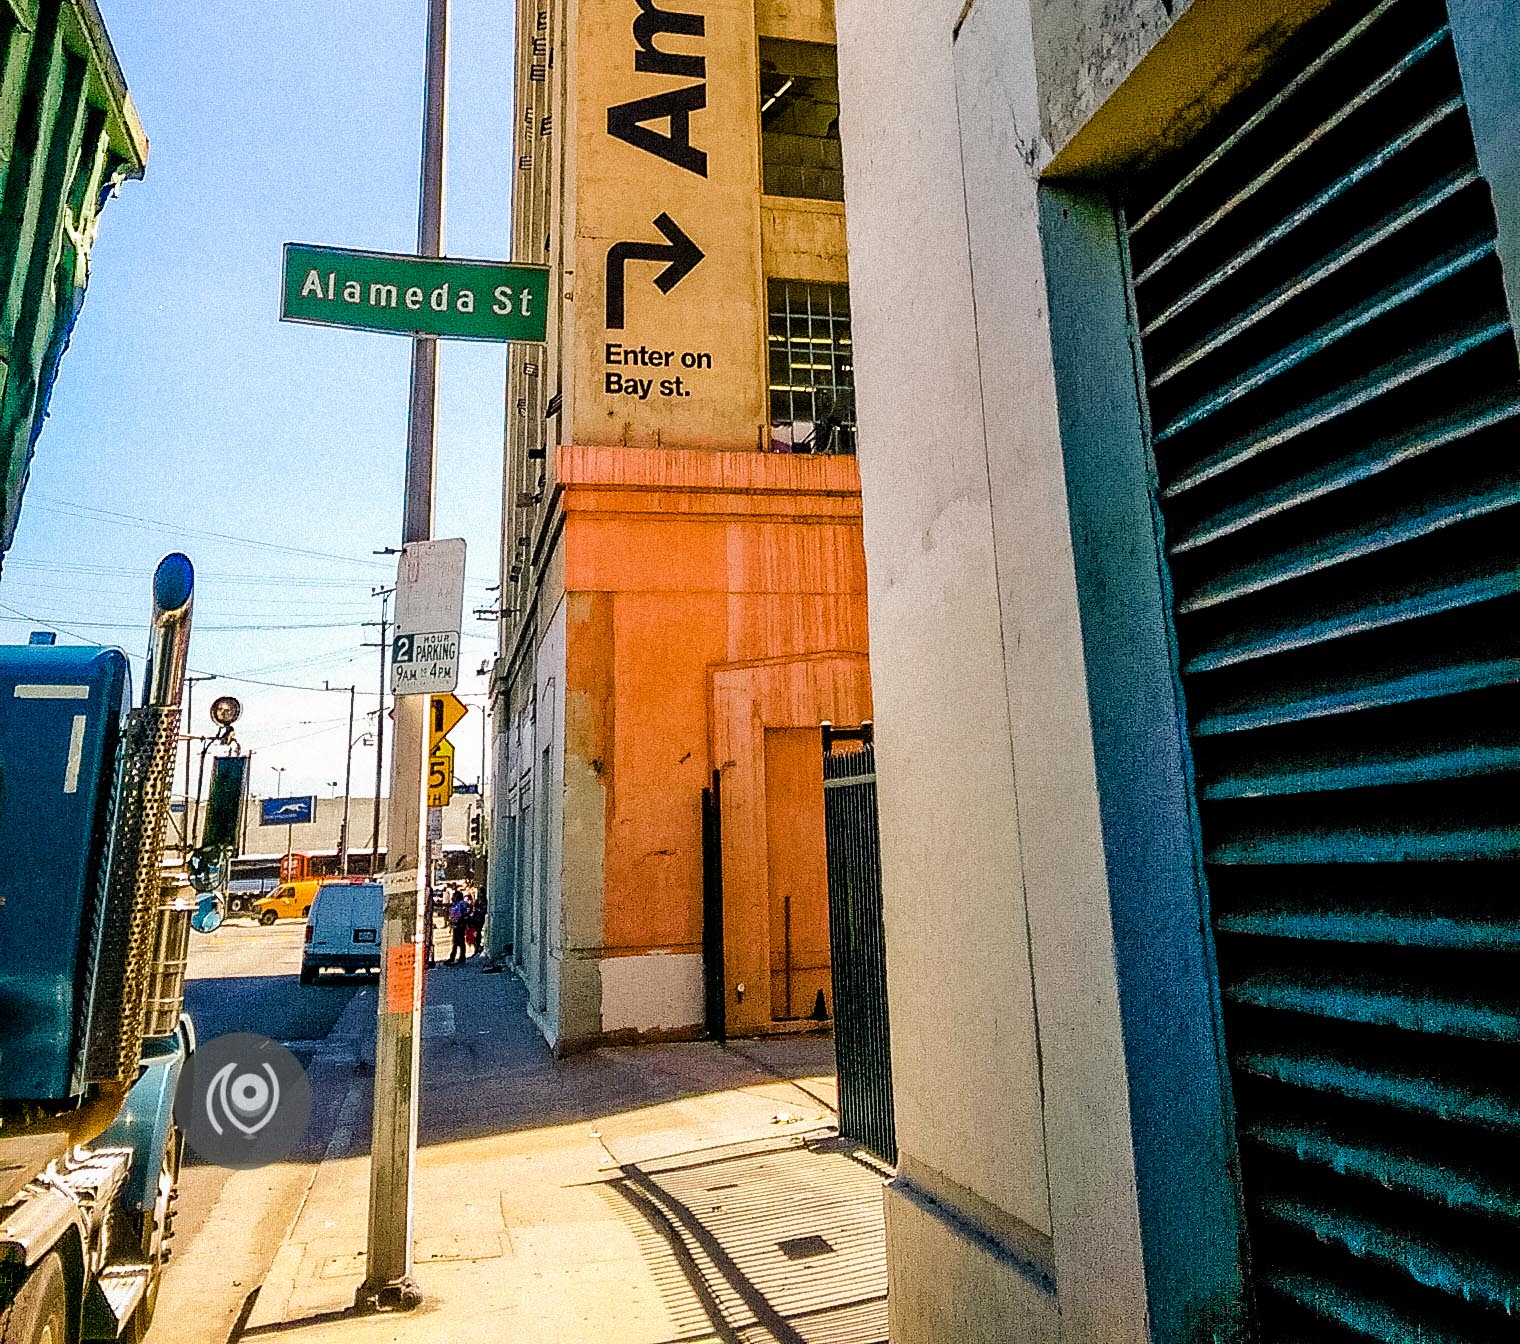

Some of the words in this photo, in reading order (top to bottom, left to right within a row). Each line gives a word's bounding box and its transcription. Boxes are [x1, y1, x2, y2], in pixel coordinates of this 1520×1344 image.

[301, 268, 475, 314] Alameda
[492, 285, 533, 317] St
[605, 343, 675, 367] Enter
[680, 352, 712, 369] on
[605, 371, 653, 400] Bay
[660, 376, 690, 396] st.
[397, 637, 409, 661] 2
[424, 635, 450, 644] HOUR
[416, 642, 456, 663] PARKING
[396, 665, 417, 681] 9AM
[430, 662, 452, 678] 4PM
